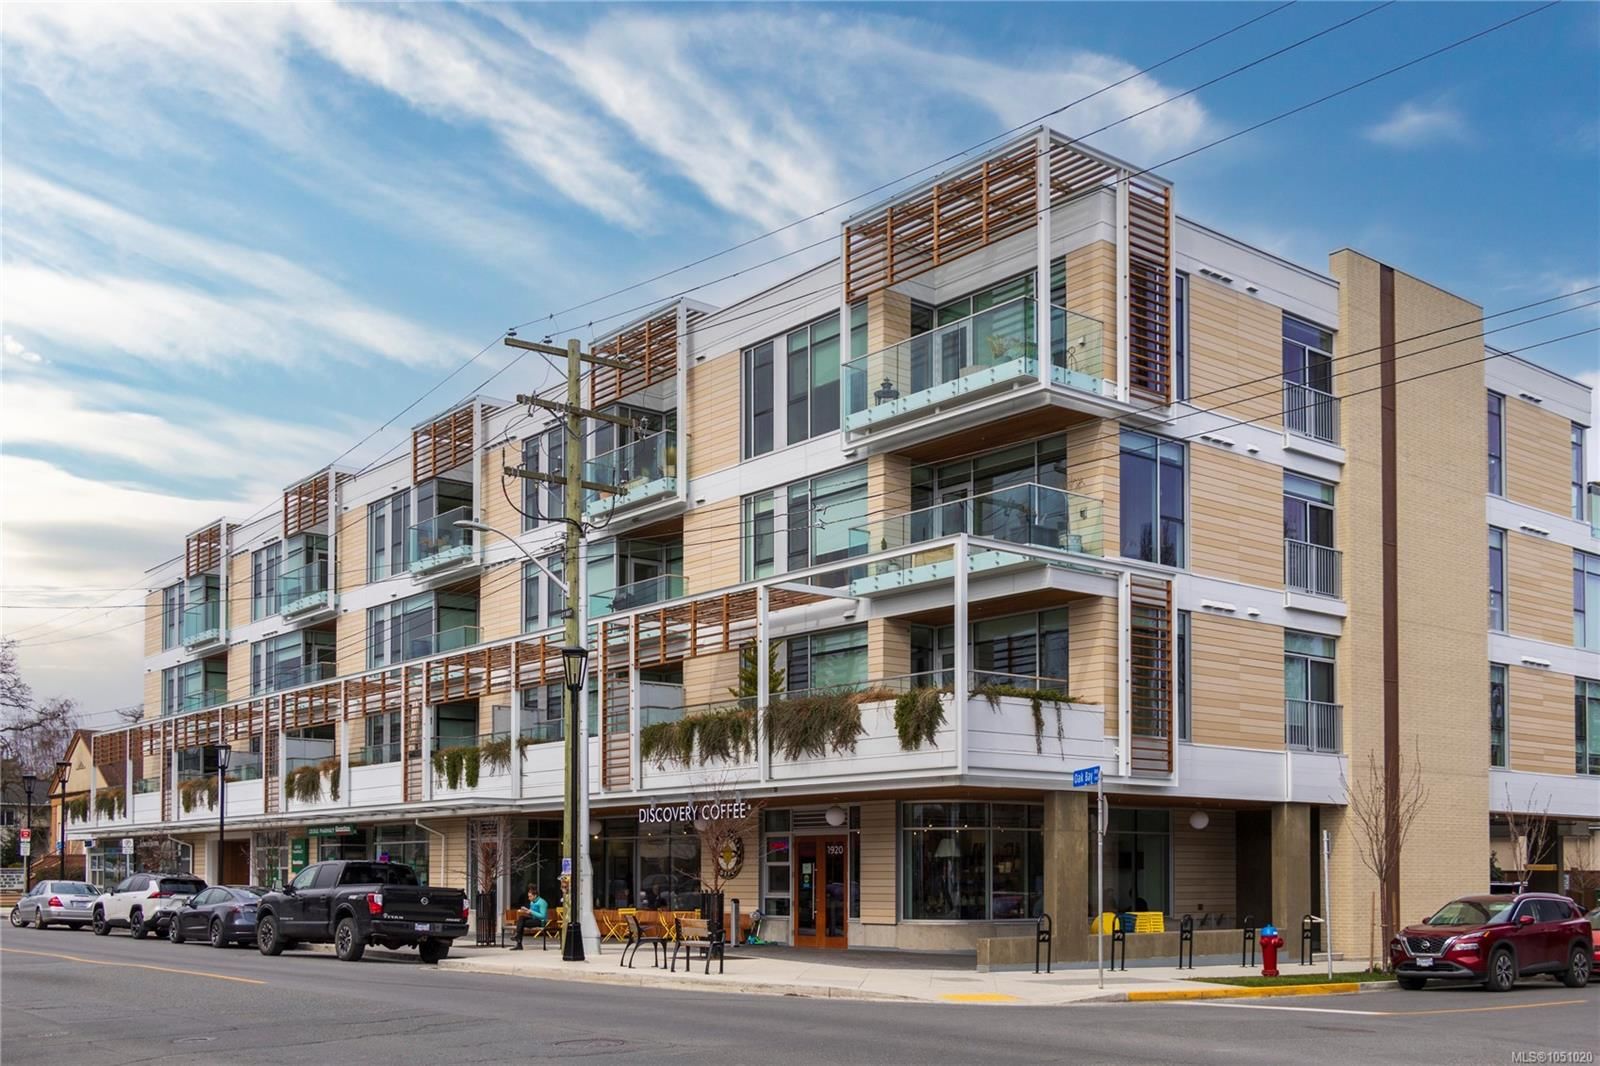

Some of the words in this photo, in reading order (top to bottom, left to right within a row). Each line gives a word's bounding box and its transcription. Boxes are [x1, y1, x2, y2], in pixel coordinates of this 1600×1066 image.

[1074, 771, 1084, 784] Oak
[1085, 771, 1093, 785] Bay
[639, 806, 698, 823] DISCOVERY
[702, 803, 745, 820] COFFEE
[827, 845, 844, 855] 1920
